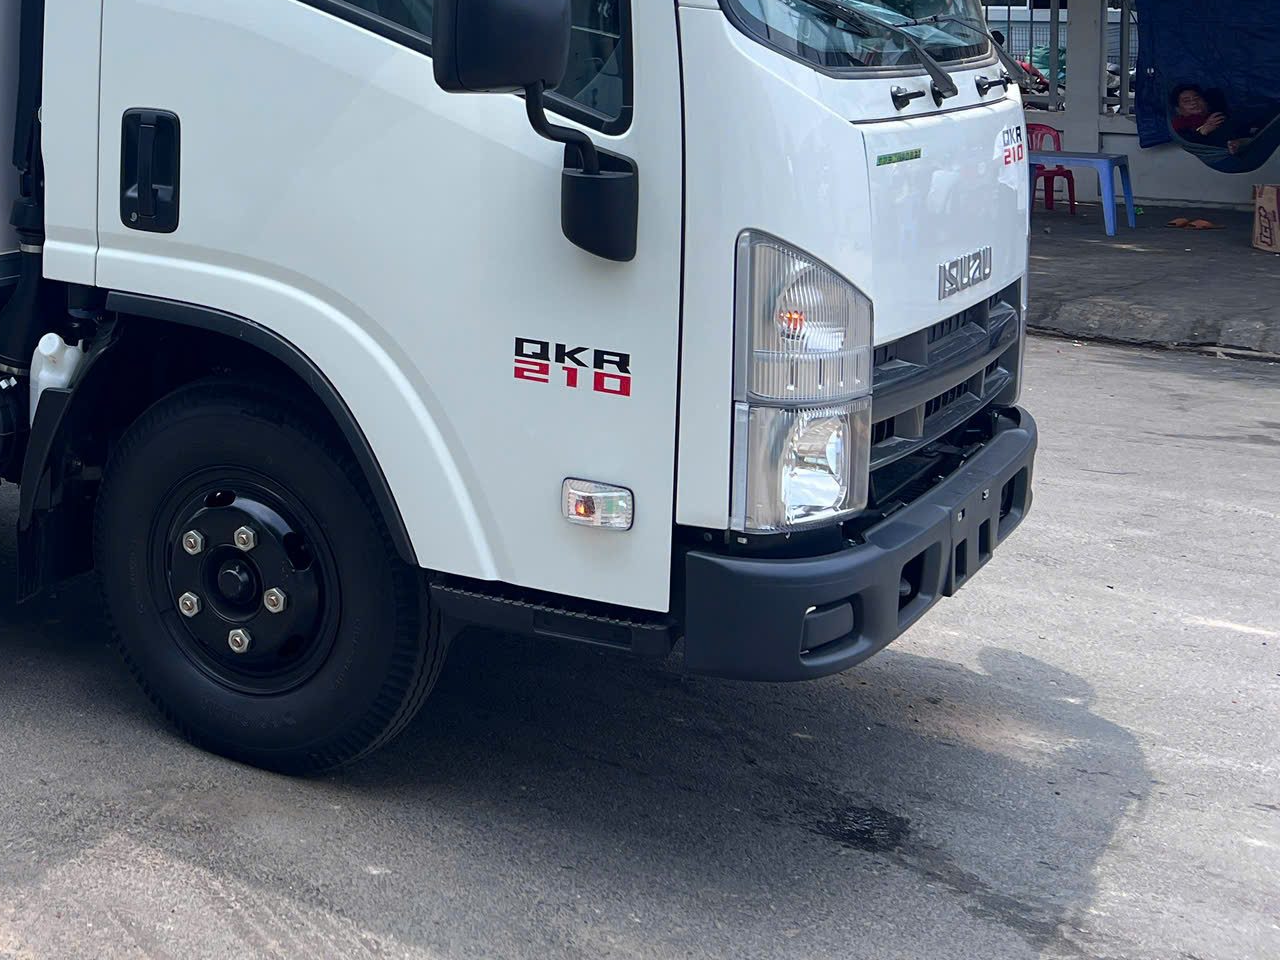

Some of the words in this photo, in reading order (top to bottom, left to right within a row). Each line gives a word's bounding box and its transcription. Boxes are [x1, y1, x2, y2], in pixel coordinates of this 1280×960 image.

[1004, 144, 1024, 165] 210
[938, 246, 992, 301] ISUZU
[515, 337, 631, 375] QKR
[514, 358, 631, 396] 210
